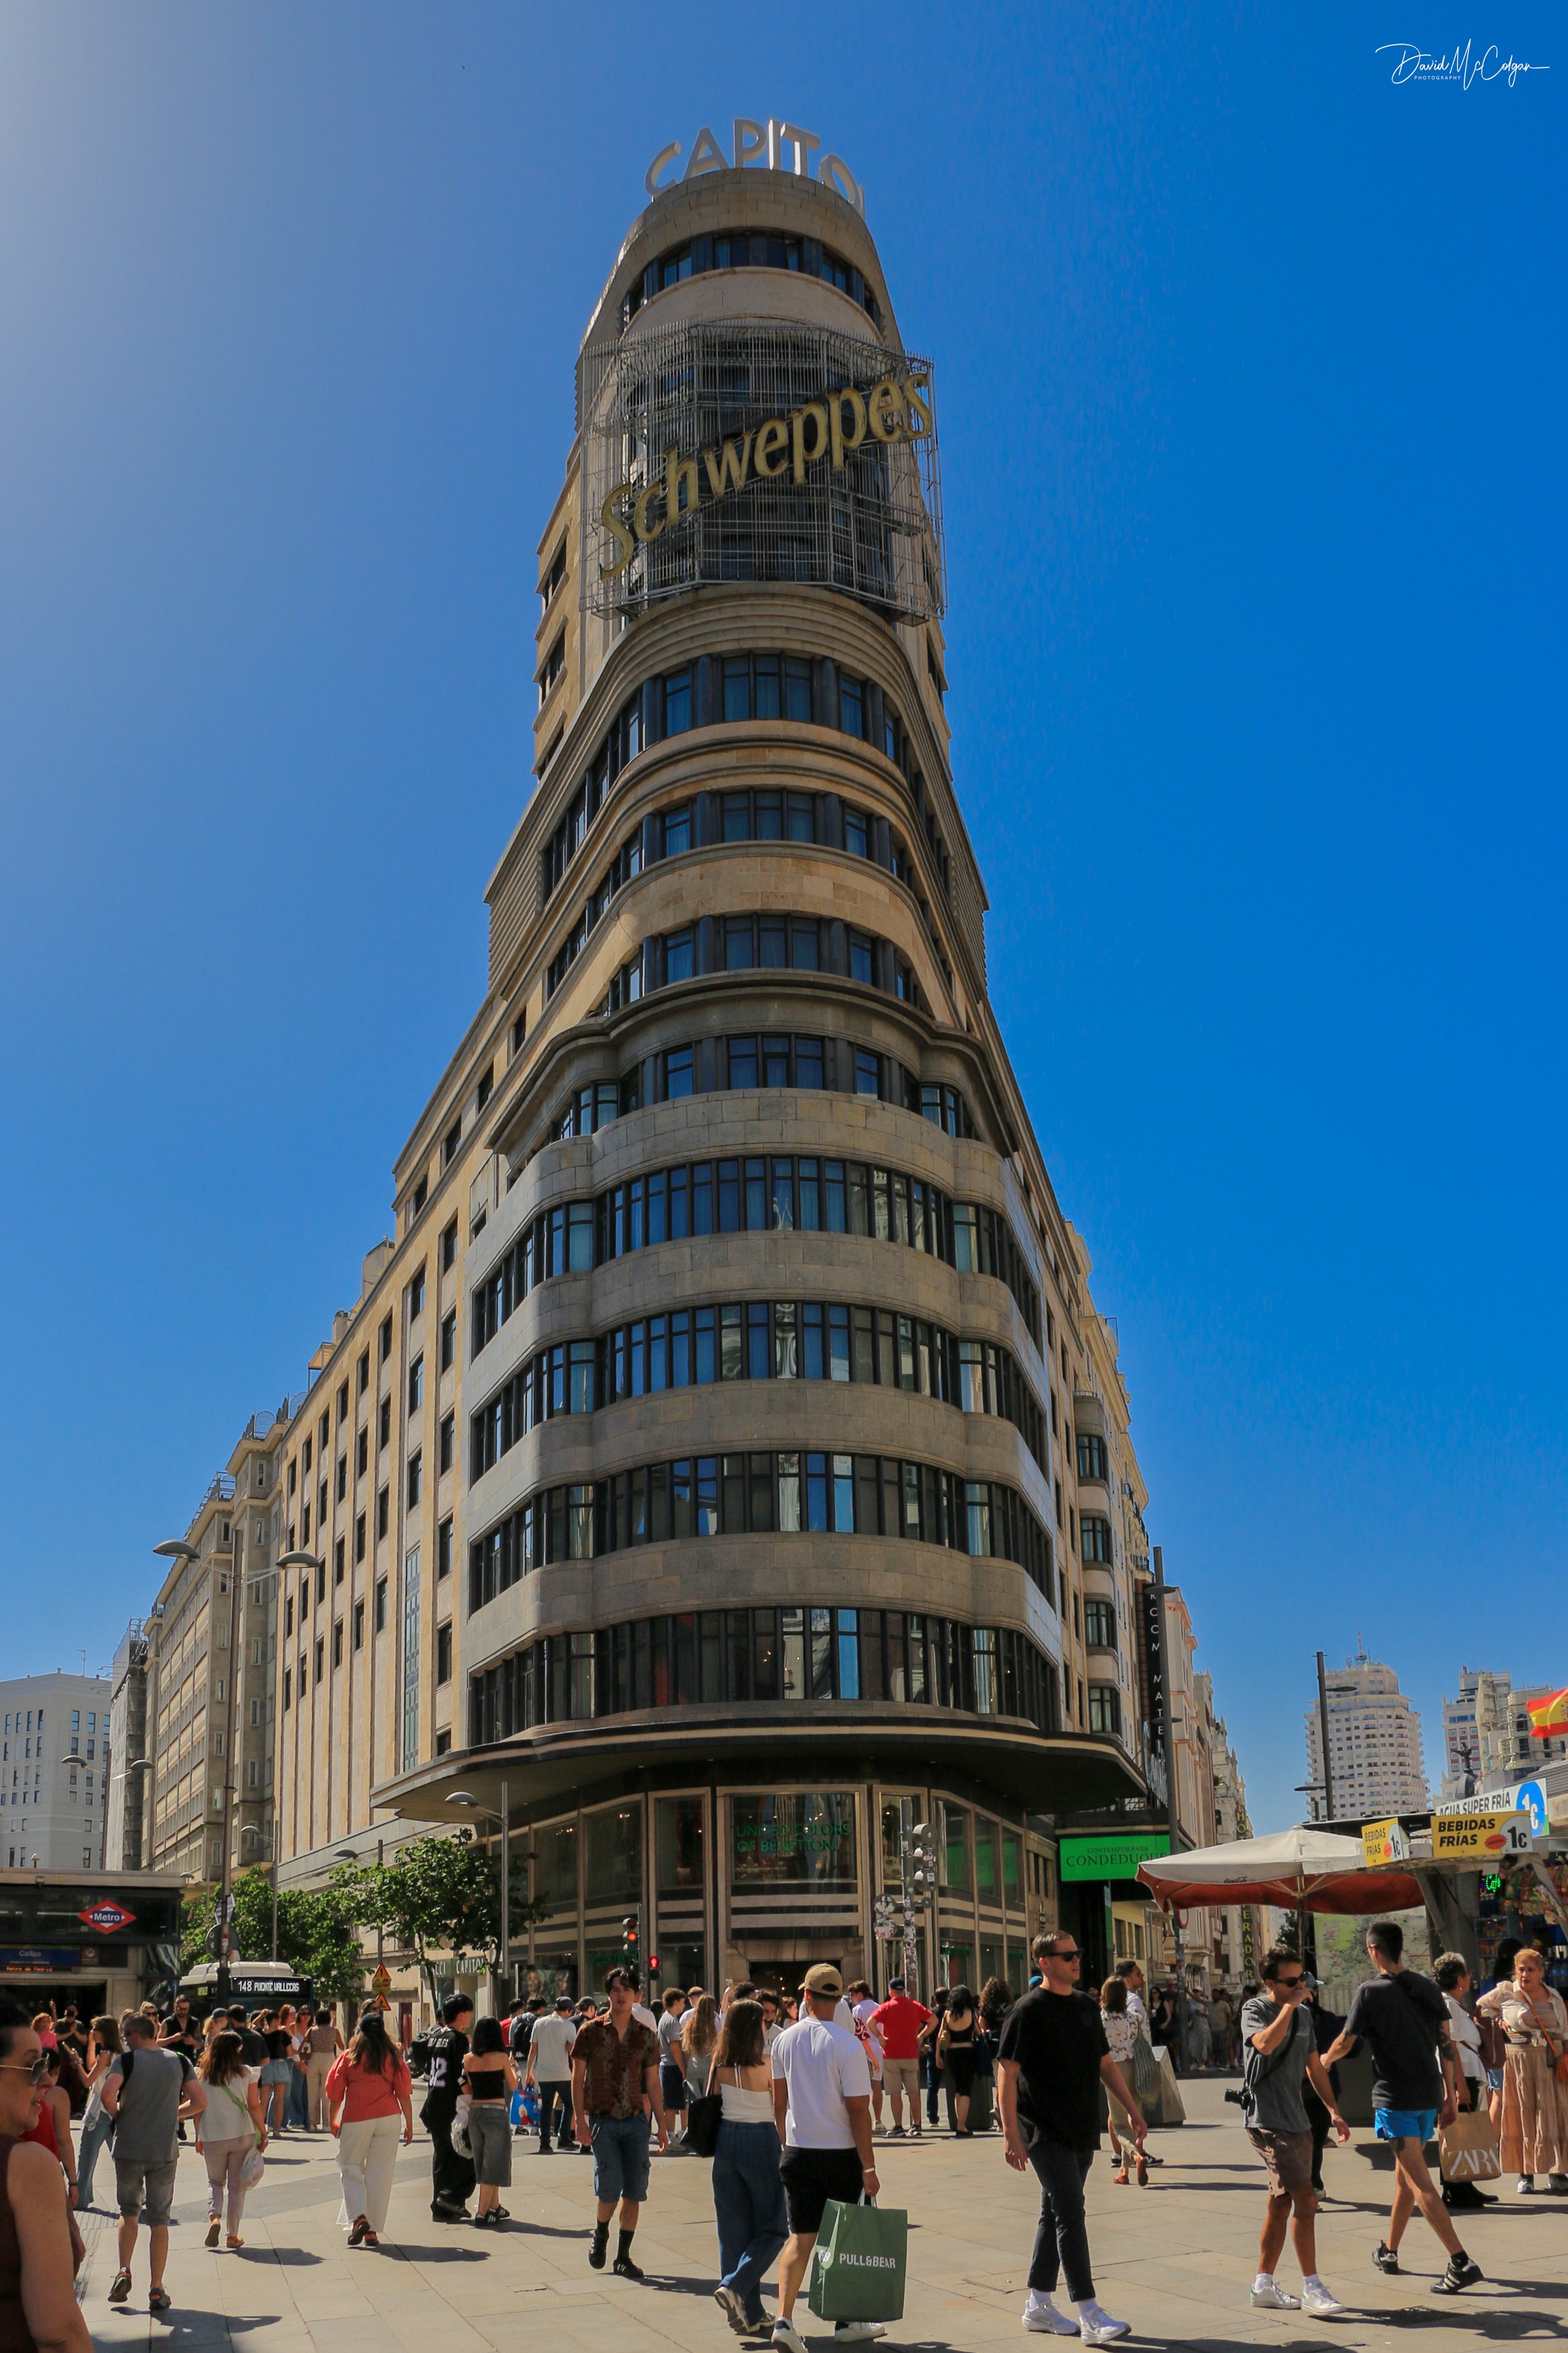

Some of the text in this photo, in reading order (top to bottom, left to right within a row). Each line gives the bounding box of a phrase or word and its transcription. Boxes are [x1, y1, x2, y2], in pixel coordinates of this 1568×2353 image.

[644, 118, 865, 221] CAPITO
[600, 372, 933, 582] Schweppes
[1462, 1797, 1490, 1815] SUPER
[1492, 1788, 1511, 1810] FRÍA
[736, 1820, 850, 1836] UNITED COLORS
[1438, 1818, 1496, 1832] BEBIDAS
[1364, 1827, 1386, 1842] BEBIDAS
[1439, 1832, 1478, 1847] FRÍAS
[1507, 1826, 1527, 1848] 1€
[737, 1840, 756, 1852] OF
[1087, 1845, 1148, 1854] CONTEMPORÁNEA
[1366, 1842, 1381, 1856] FRÍAS
[94, 1913, 120, 1921] Metro
[1243, 1903, 1254, 1979] ERADOR
[238, 1981, 252, 1992] 148
[254, 1981, 273, 1992] PUENTE
[1447, 2148, 1501, 2176] ZARA
[839, 2253, 896, 2269] PULL&BEAR
